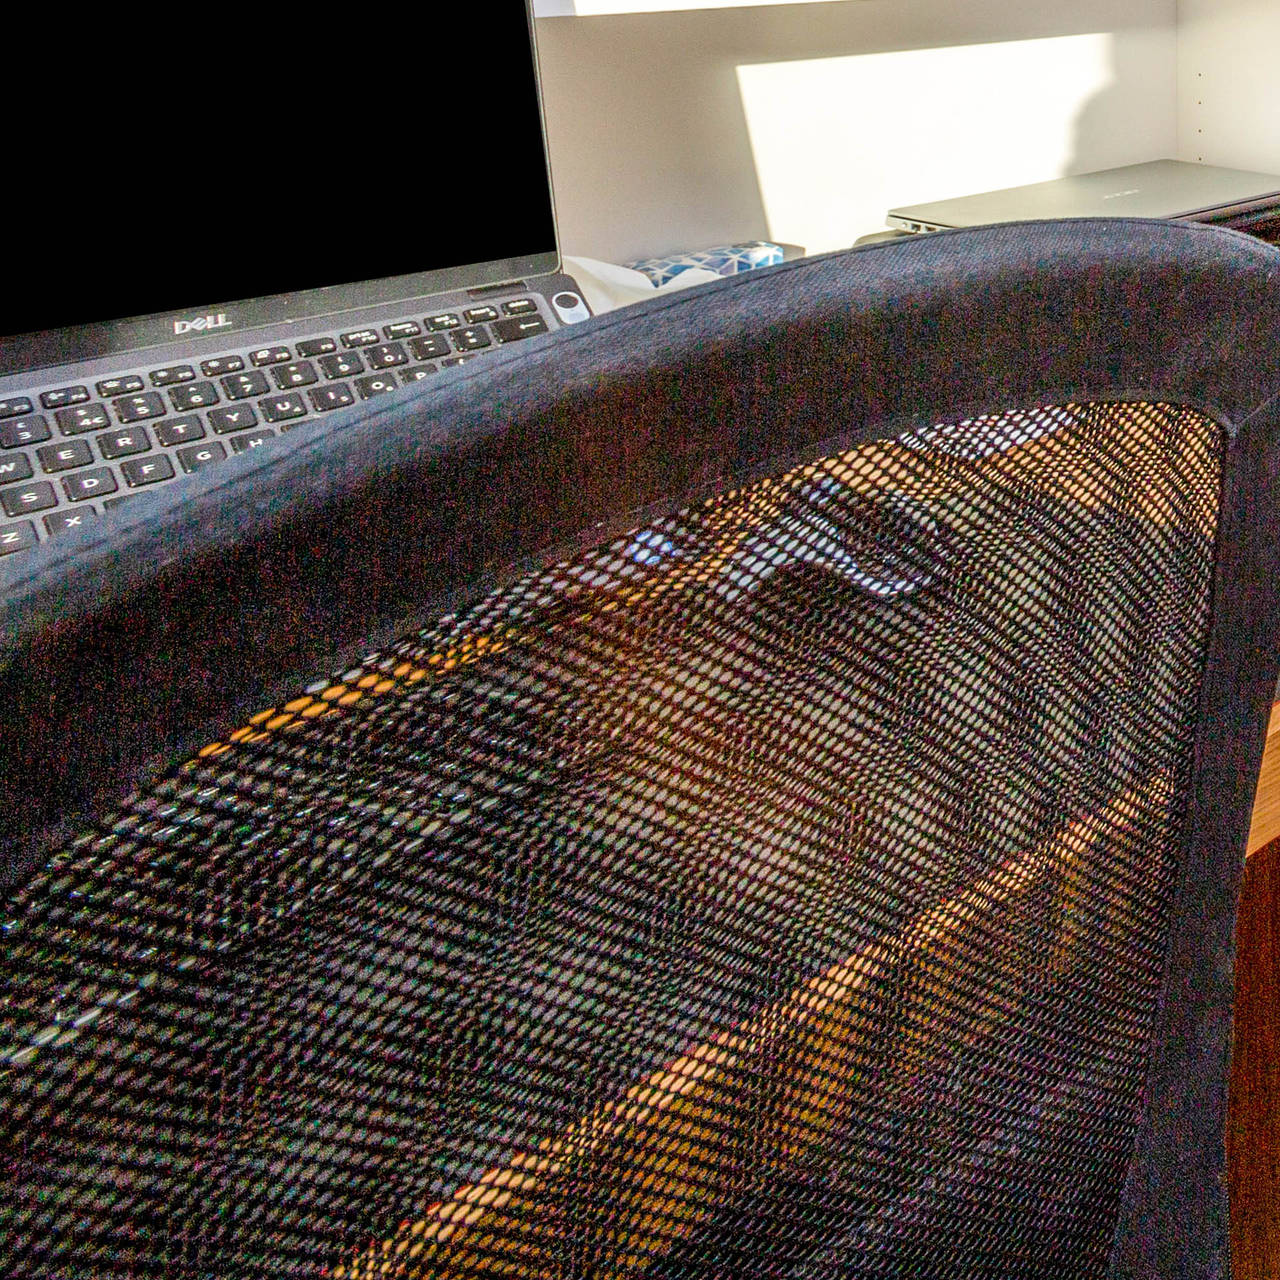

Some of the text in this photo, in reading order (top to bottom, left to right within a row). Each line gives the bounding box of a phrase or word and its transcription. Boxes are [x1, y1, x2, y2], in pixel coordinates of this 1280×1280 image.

[174, 313, 233, 335] DELL
[371, 380, 385, 390] O
[136, 405, 150, 415] 5
[275, 401, 290, 411] U
[225, 412, 240, 422] Y
[172, 424, 188, 434] T
[116, 436, 134, 448] R
[59, 449, 76, 460] E
[196, 450, 212, 460] G
[141, 464, 157, 475] F
[81, 478, 100, 489] D
[22, 492, 39, 503] S
[65, 516, 82, 528] X
[1, 532, 20, 543] Z
